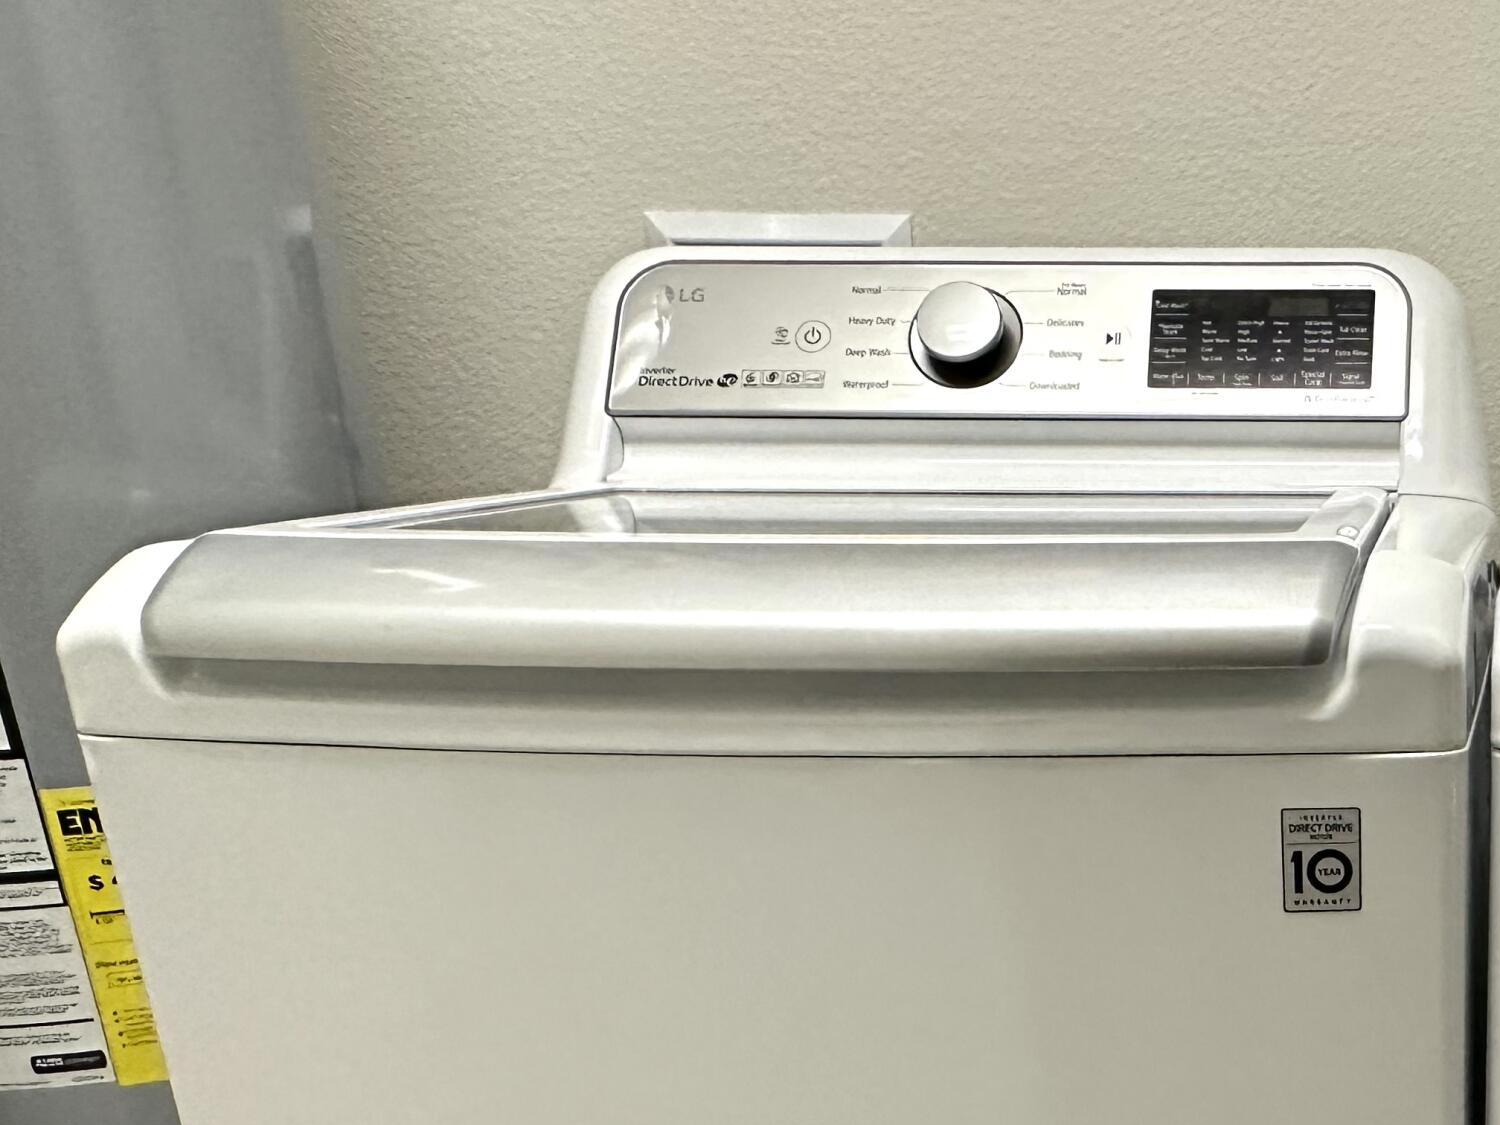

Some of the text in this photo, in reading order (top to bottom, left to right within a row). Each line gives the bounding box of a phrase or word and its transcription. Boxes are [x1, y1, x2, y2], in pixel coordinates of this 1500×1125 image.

[679, 287, 705, 303] LG
[852, 286, 882, 295] Normal
[876, 316, 896, 326] Duty
[1288, 823, 1353, 833] DIRECT DRIVE
[1290, 849, 1353, 895] 10
[1317, 868, 1342, 877] YEAR
